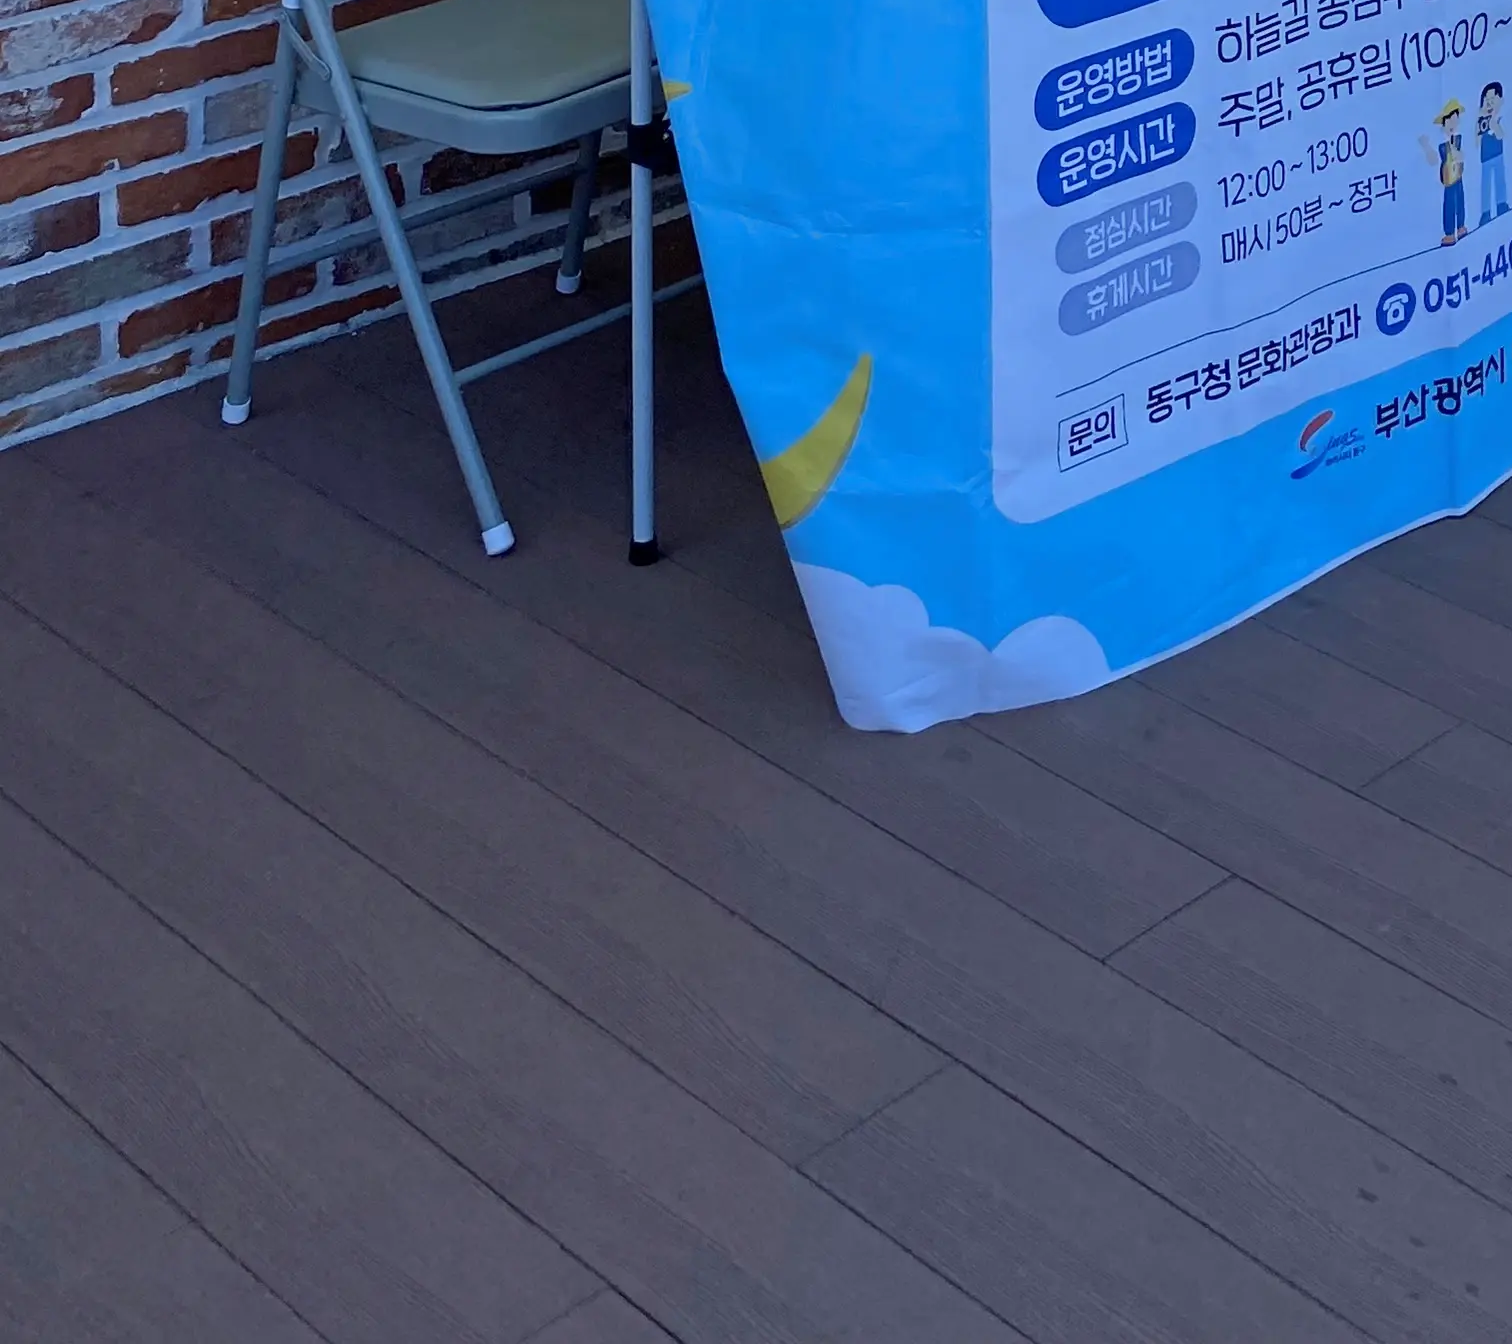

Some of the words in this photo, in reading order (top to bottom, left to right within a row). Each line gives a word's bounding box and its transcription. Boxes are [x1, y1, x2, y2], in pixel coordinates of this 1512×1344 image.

[1055, 38, 1173, 119] 운영방법
[1058, 113, 1176, 195] 운영시간
[1217, 75, 1293, 138] 주말,
[1296, 38, 1393, 111] 공휴일
[1083, 193, 1172, 260] 점심시간
[1086, 254, 1173, 322] 휴게시간
[1220, 218, 1272, 265] 매시
[1275, 194, 1325, 246] 50분
[1348, 169, 1399, 214] 정각
[1067, 405, 1118, 458] 문의
[1145, 358, 1233, 424] 동구청
[1236, 303, 1362, 391] 문화관광과
[1374, 346, 1506, 439] 부산광역시
